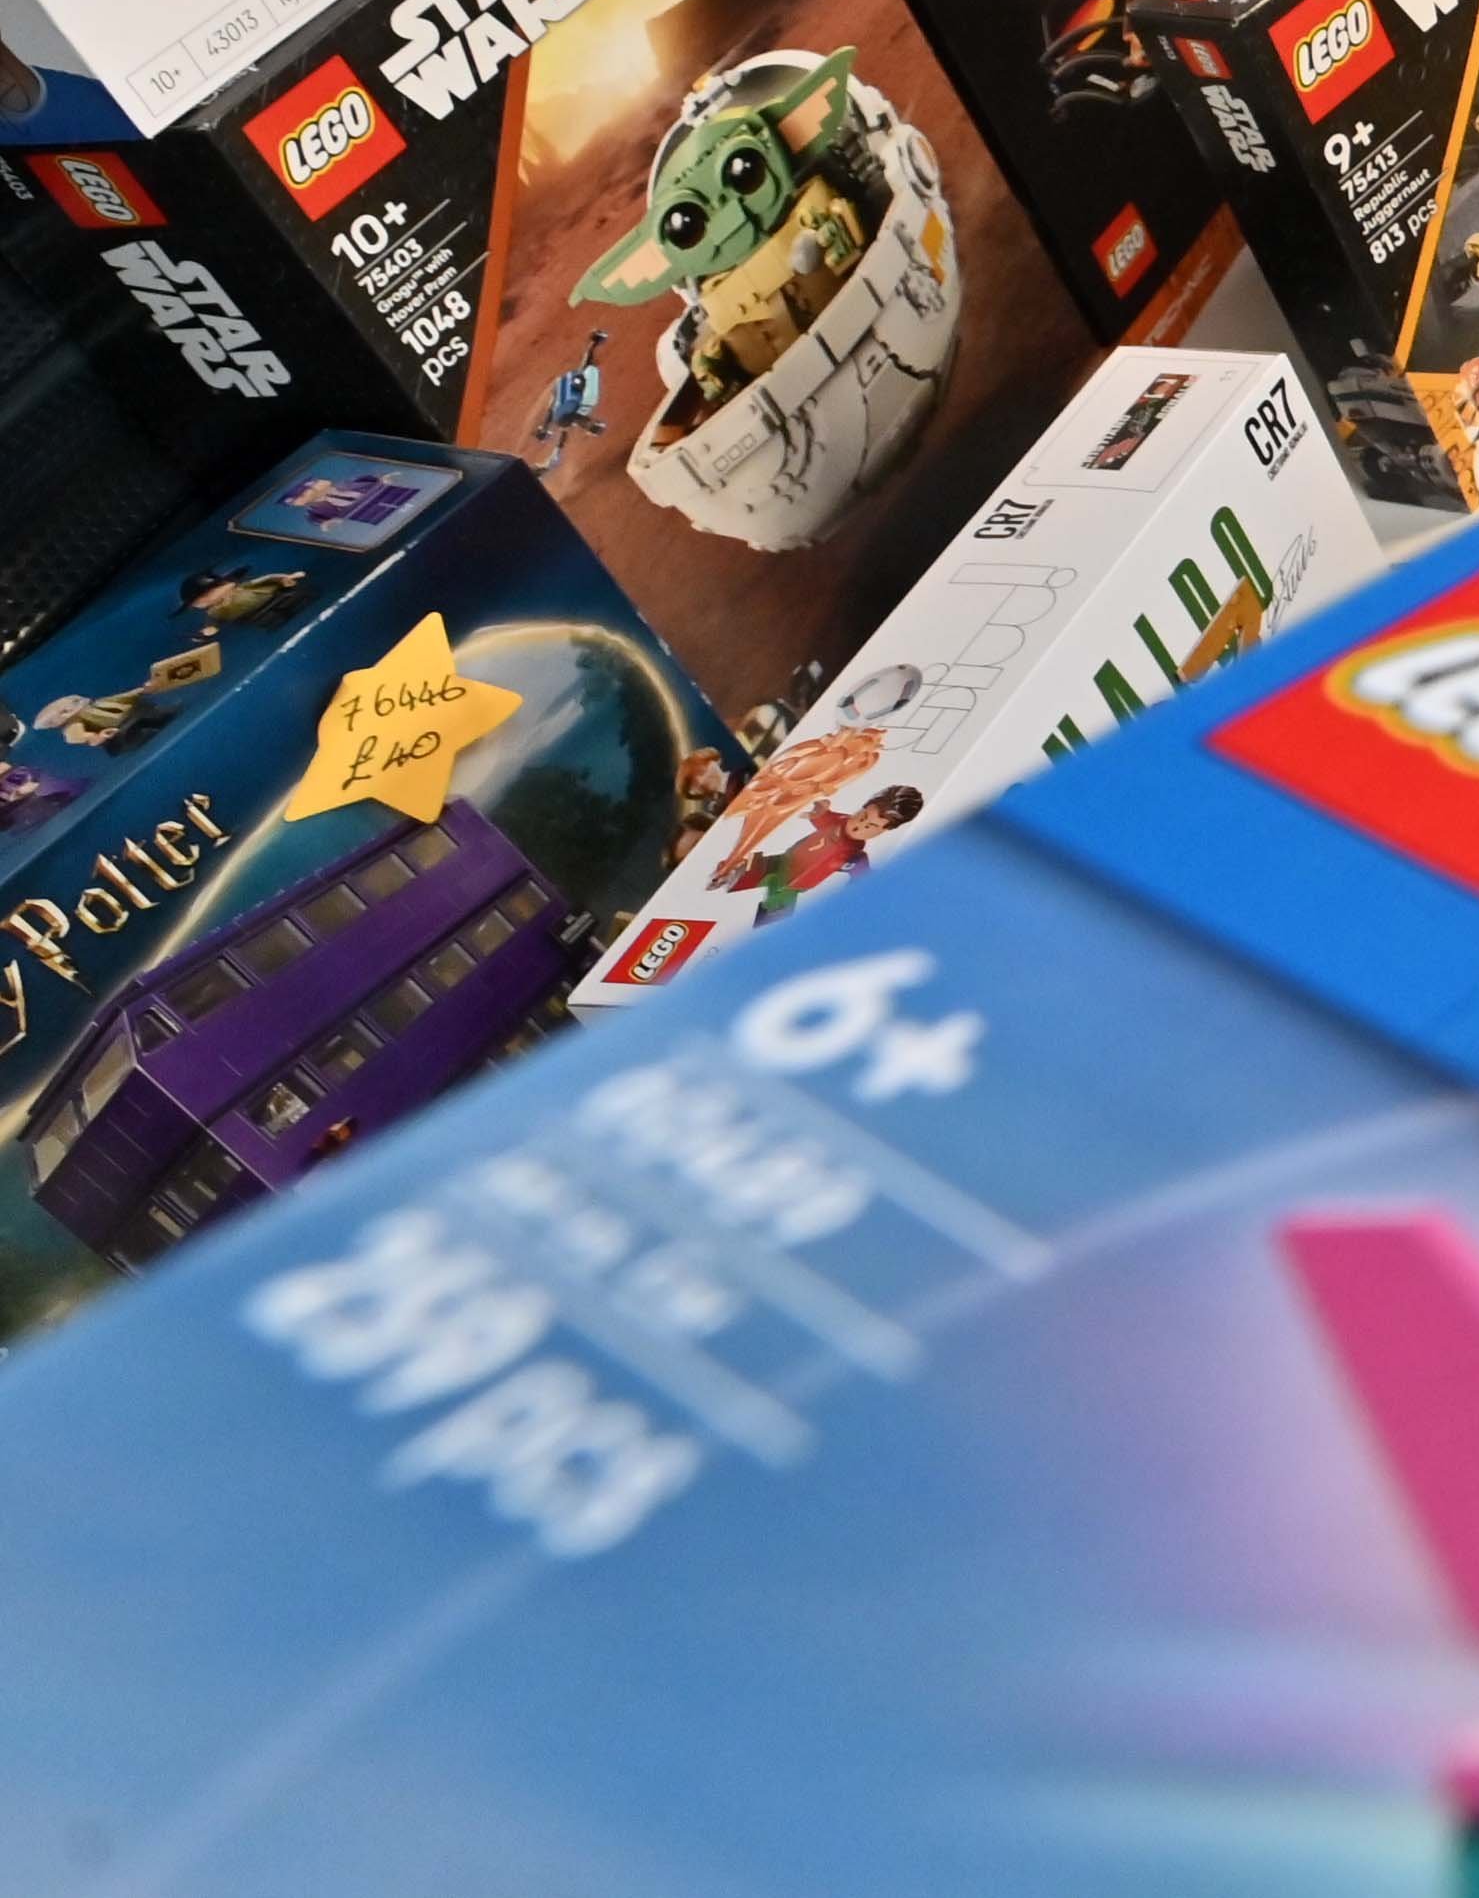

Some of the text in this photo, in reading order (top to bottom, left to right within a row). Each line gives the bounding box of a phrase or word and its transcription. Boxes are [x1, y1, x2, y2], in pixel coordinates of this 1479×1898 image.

[149, 66, 182, 97] 10+
[204, 10, 260, 58] 43013
[282, 89, 371, 186] LEGO
[1200, 85, 1269, 174] WARS
[1216, 84, 1278, 172] STAR
[1323, 120, 1375, 175] 9+
[59, 158, 137, 222] LEGO
[1340, 143, 1399, 201] 75413
[1353, 169, 1409, 222] Republic
[1362, 168, 1432, 236] Juggernaut
[331, 200, 408, 269] 10+
[424, 247, 454, 275] with
[1369, 198, 1439, 264] 813 pcs
[357, 237, 424, 297] 75403
[385, 265, 458, 328] Hover Pram
[100, 240, 266, 398] WARS
[139, 239, 292, 398] STAR
[401, 290, 471, 356] 1048
[421, 335, 470, 387] pcs
[1243, 376, 1297, 467] CR7
[973, 498, 1038, 540] CR7
[339, 675, 468, 733] 76446
[344, 730, 442, 788] £40
[632, 921, 688, 983] LEGO
[729, 945, 986, 1103] 6+
